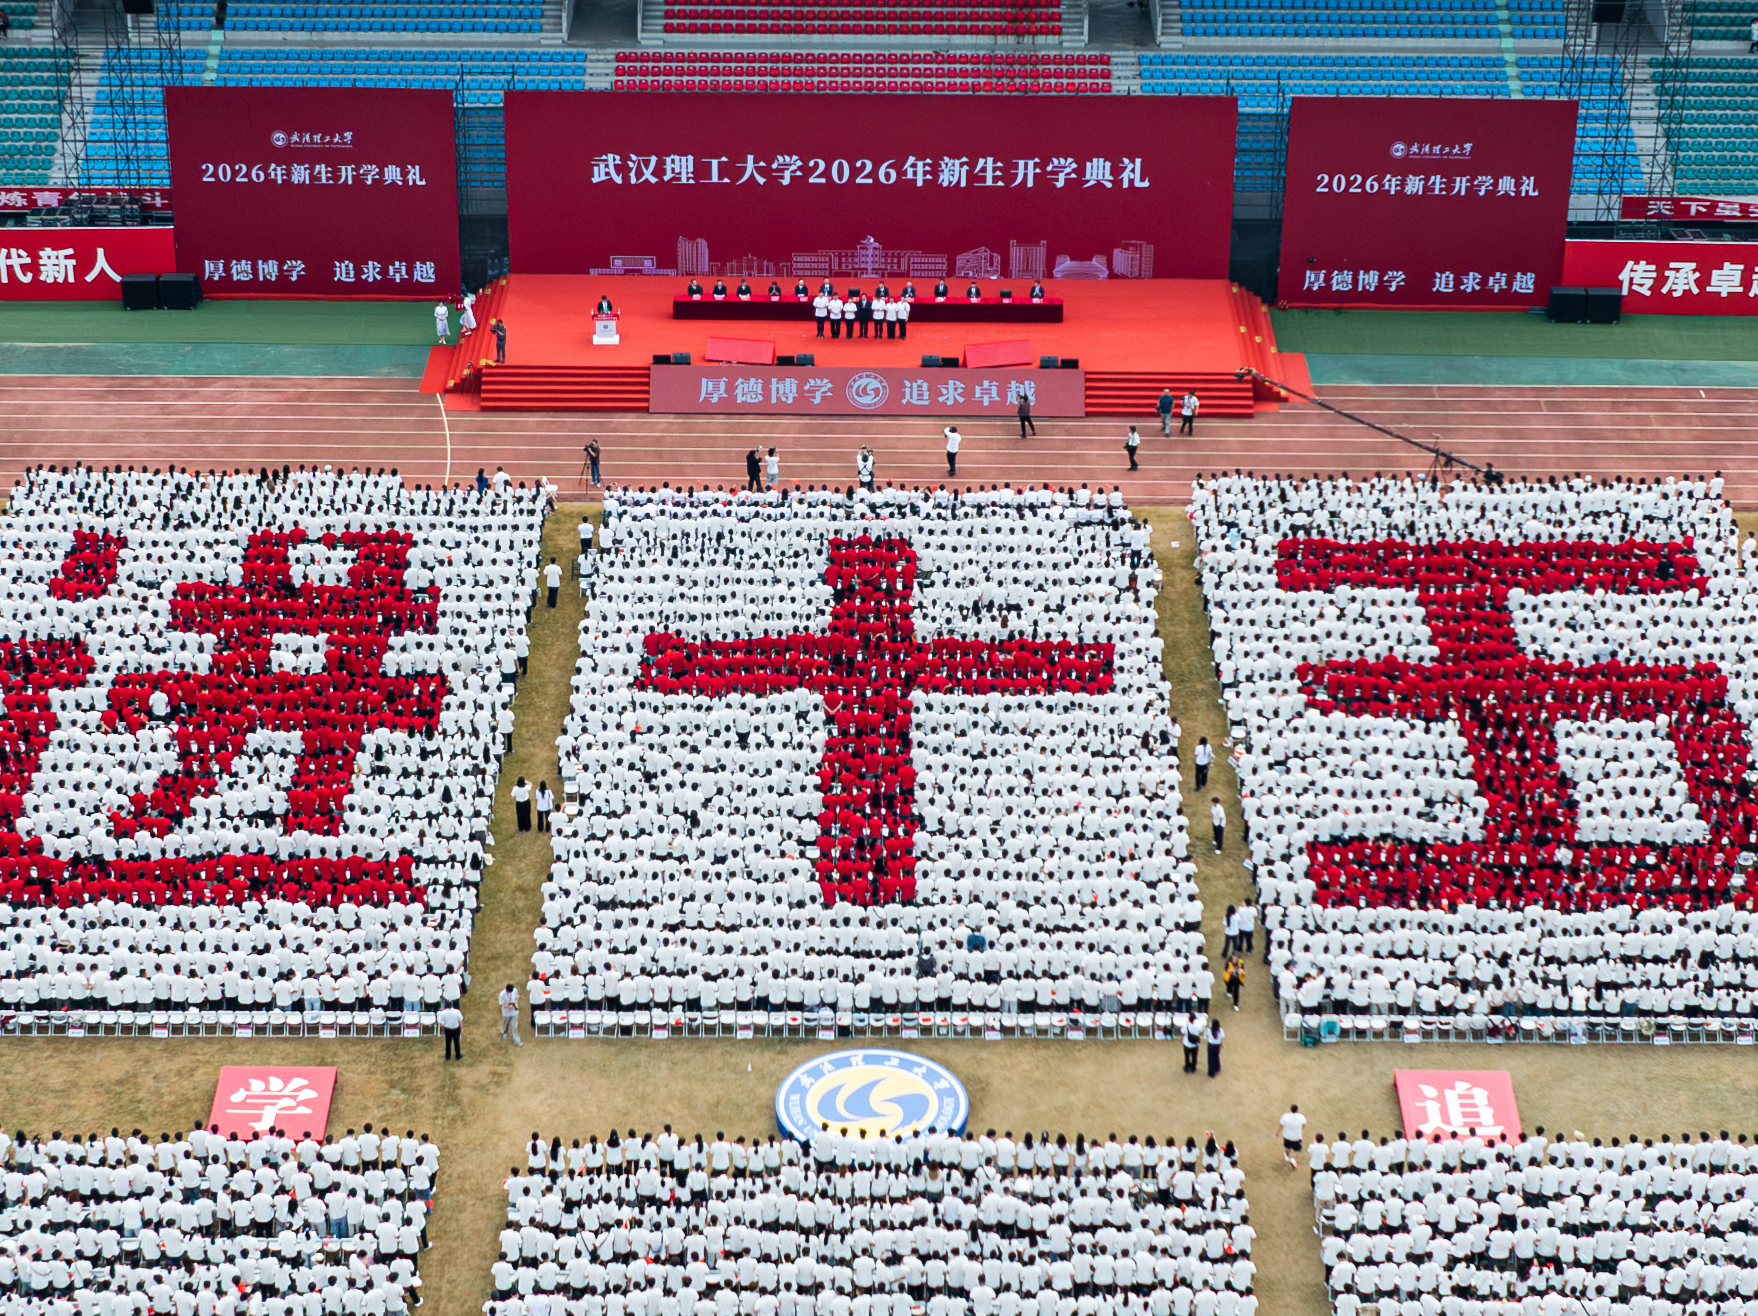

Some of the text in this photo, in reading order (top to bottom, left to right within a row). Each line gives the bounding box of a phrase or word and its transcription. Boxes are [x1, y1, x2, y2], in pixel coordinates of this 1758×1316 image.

[202, 163, 427, 186] 2026年新生开学典礼
[591, 154, 1150, 189] 武汉理工大学2026年新生开学典礼
[1316, 174, 1539, 197] 2026年新生开学典礼
[204, 259, 436, 283] 厚德博学 追求卓越
[1303, 269, 1536, 293] 厚德博学 追求卓越
[698, 377, 1036, 406] 厚德博学 追求卓越
[224, 1075, 319, 1127] 学
[1415, 1081, 1497, 1139] 追
